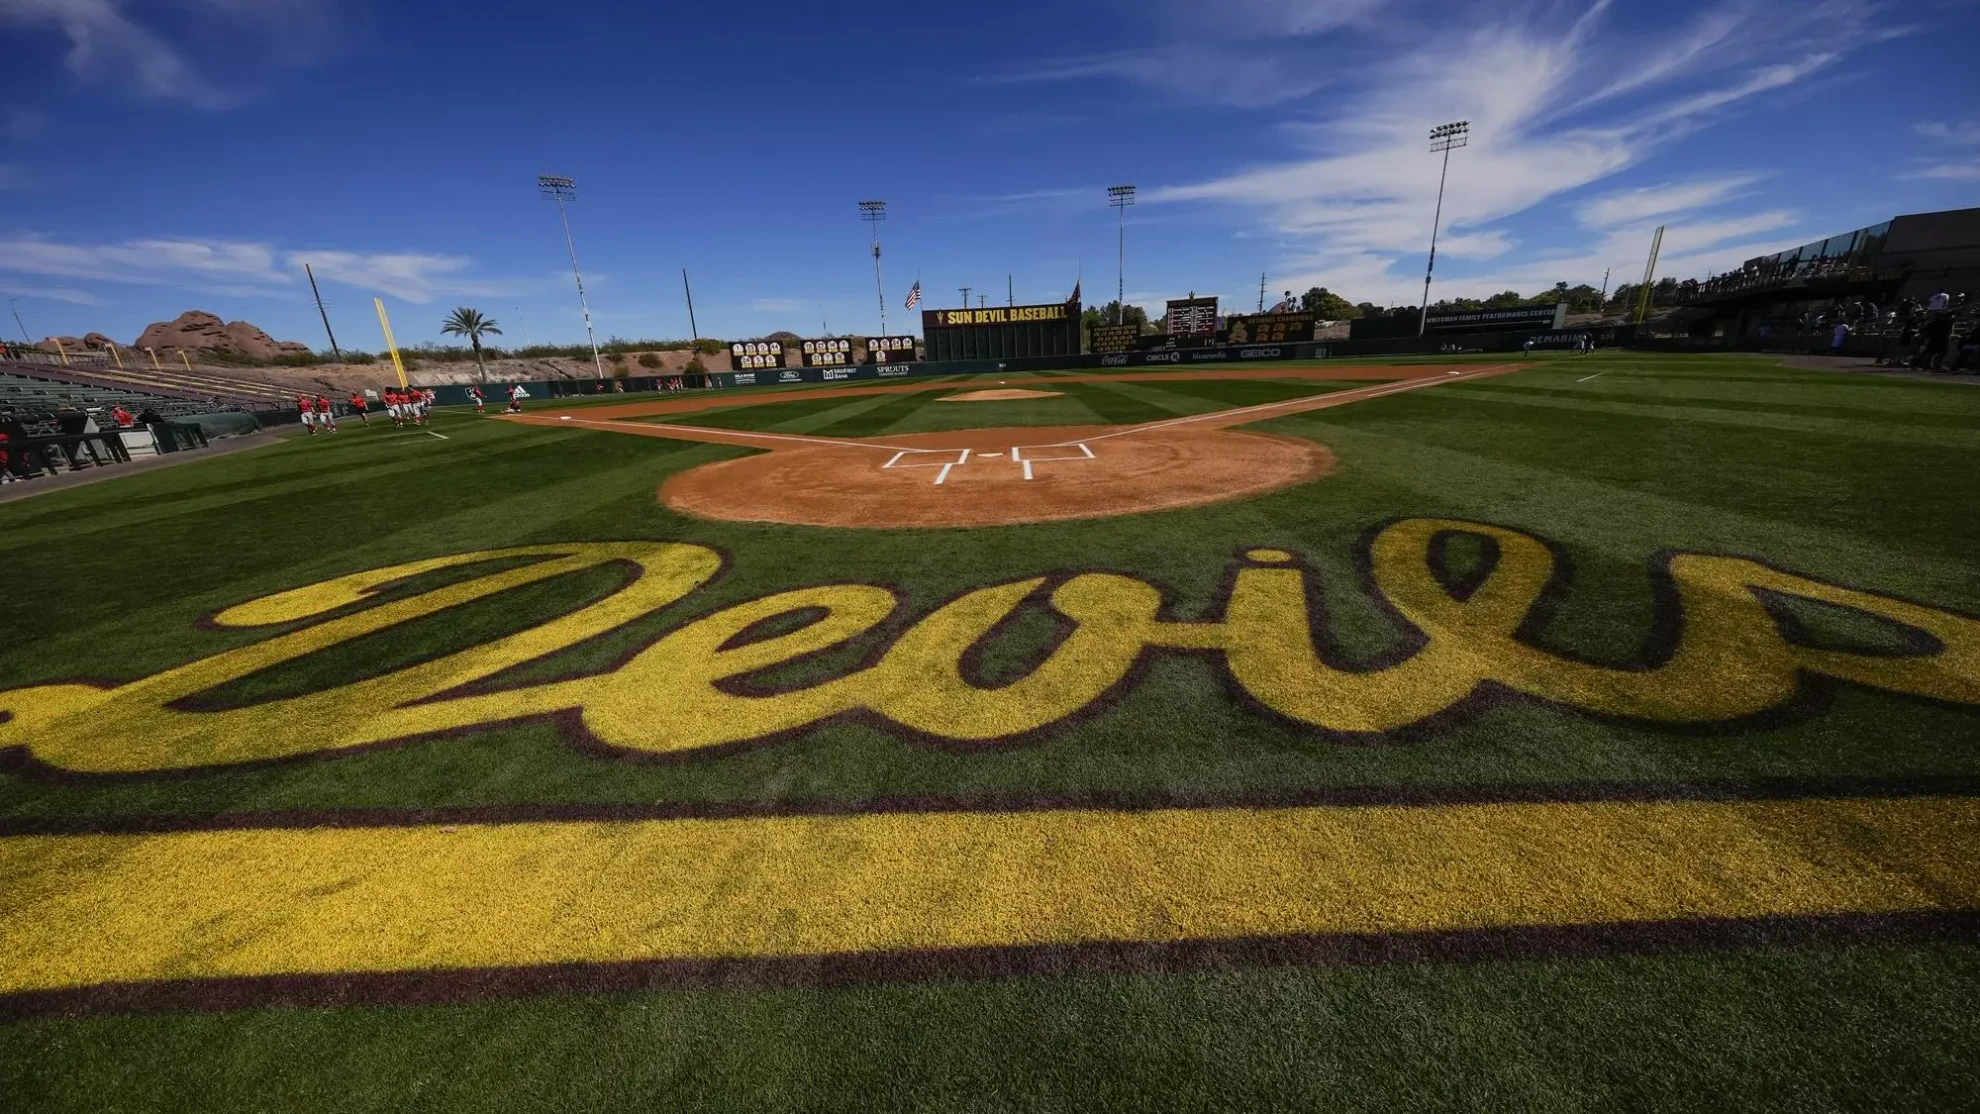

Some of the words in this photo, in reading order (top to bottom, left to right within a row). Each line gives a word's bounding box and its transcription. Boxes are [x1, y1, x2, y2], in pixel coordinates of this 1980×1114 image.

[947, 311, 973, 325] SUN
[975, 309, 1008, 323] DEVIL
[1009, 306, 1068, 322] BASEBALL
[1458, 313, 1480, 321] FAMILY
[1481, 311, 1528, 320] PERFORMANCE
[1529, 308, 1556, 317] CENTER
[1146, 353, 1170, 362] CIRCLE
[1240, 348, 1281, 358] GEICO
[876, 365, 909, 373] SPROUTS
[0, 515, 1980, 778] Devils
